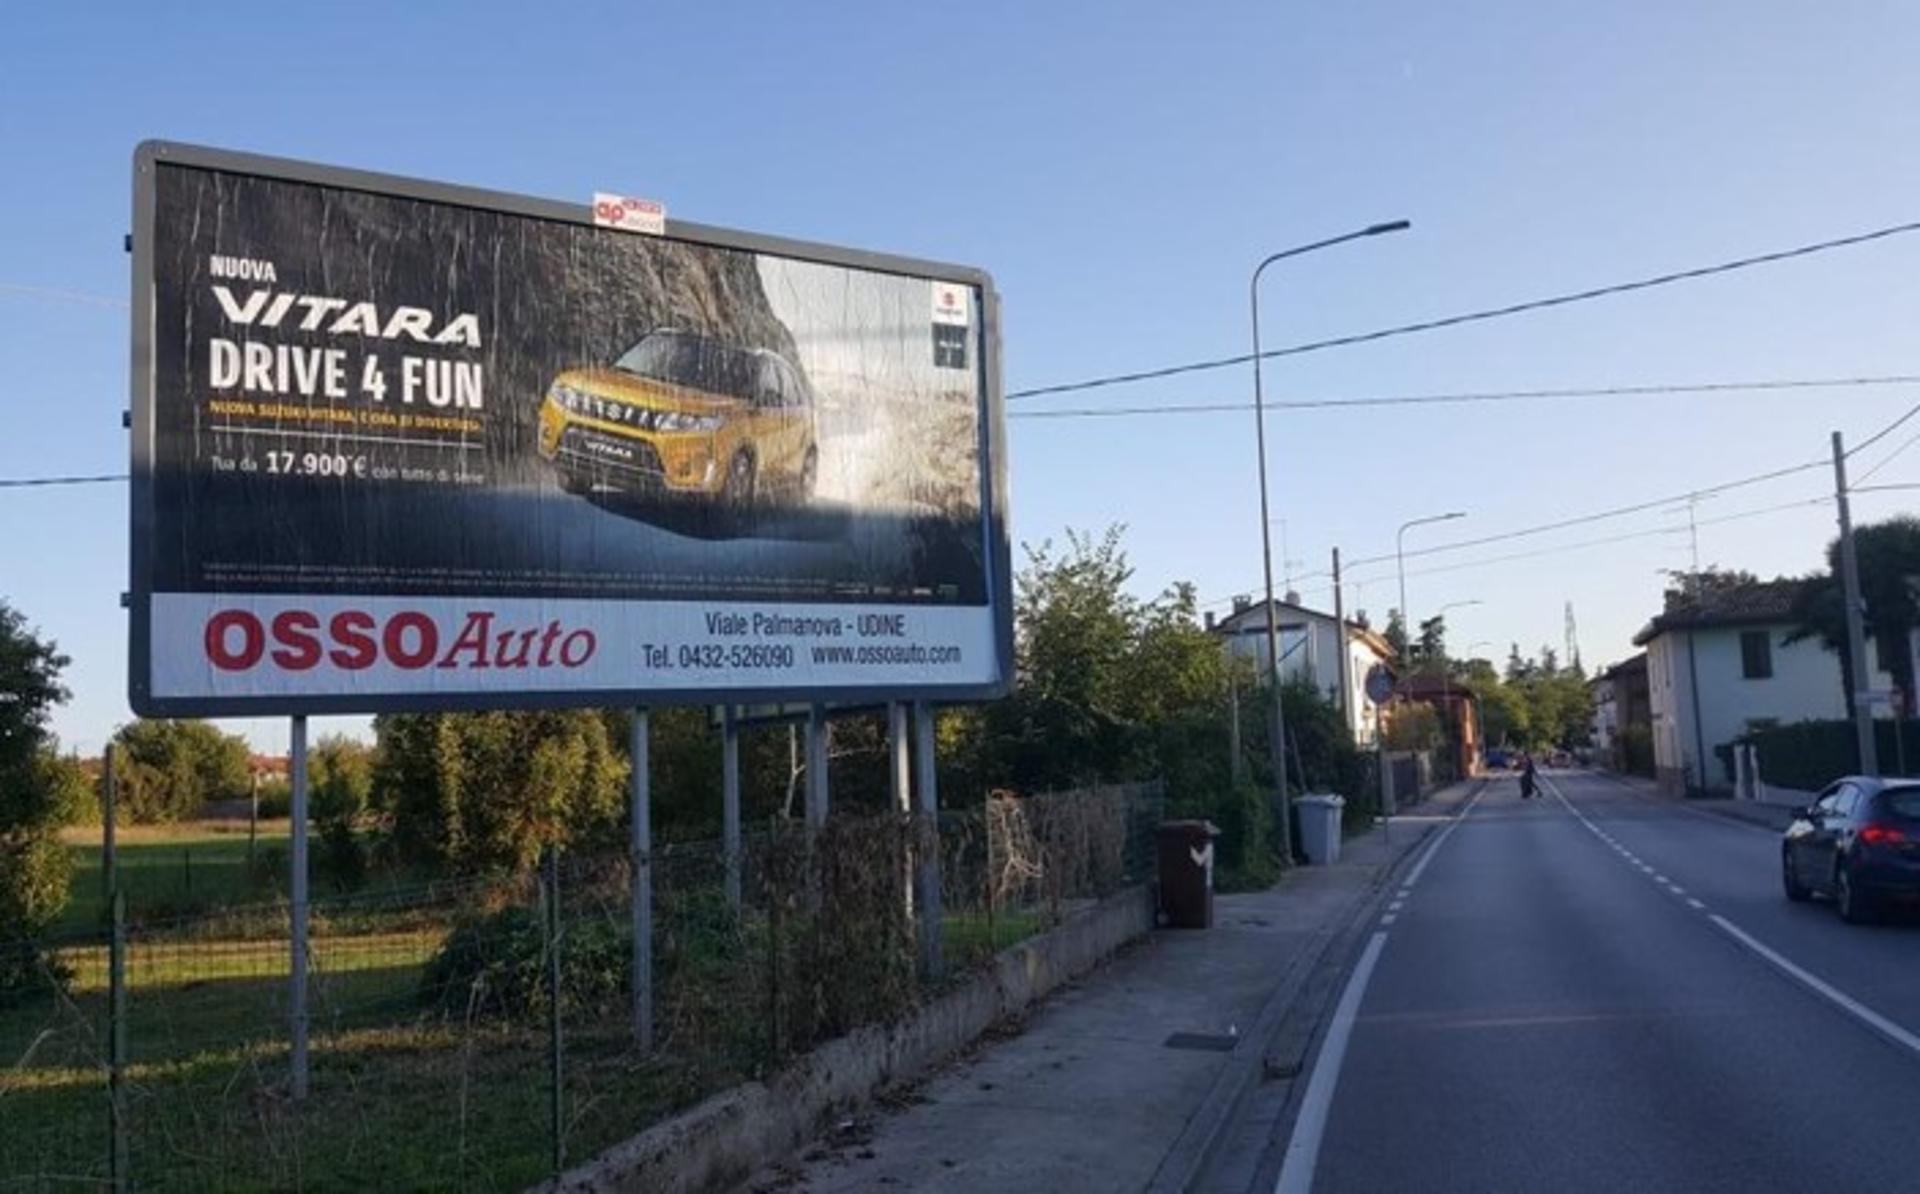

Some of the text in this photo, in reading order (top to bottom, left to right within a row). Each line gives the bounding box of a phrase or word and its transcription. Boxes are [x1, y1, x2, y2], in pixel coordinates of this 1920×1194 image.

[209, 254, 277, 282] NUOVA
[211, 285, 482, 348] VITARA
[209, 338, 482, 409] DRIVE 4 FUN
[705, 611, 749, 636] Viale
[753, 612, 842, 637] Palmanova
[857, 614, 906, 637] UDINE
[643, 642, 963, 669] Tel. 0432-526090 www.ossoauto.com
